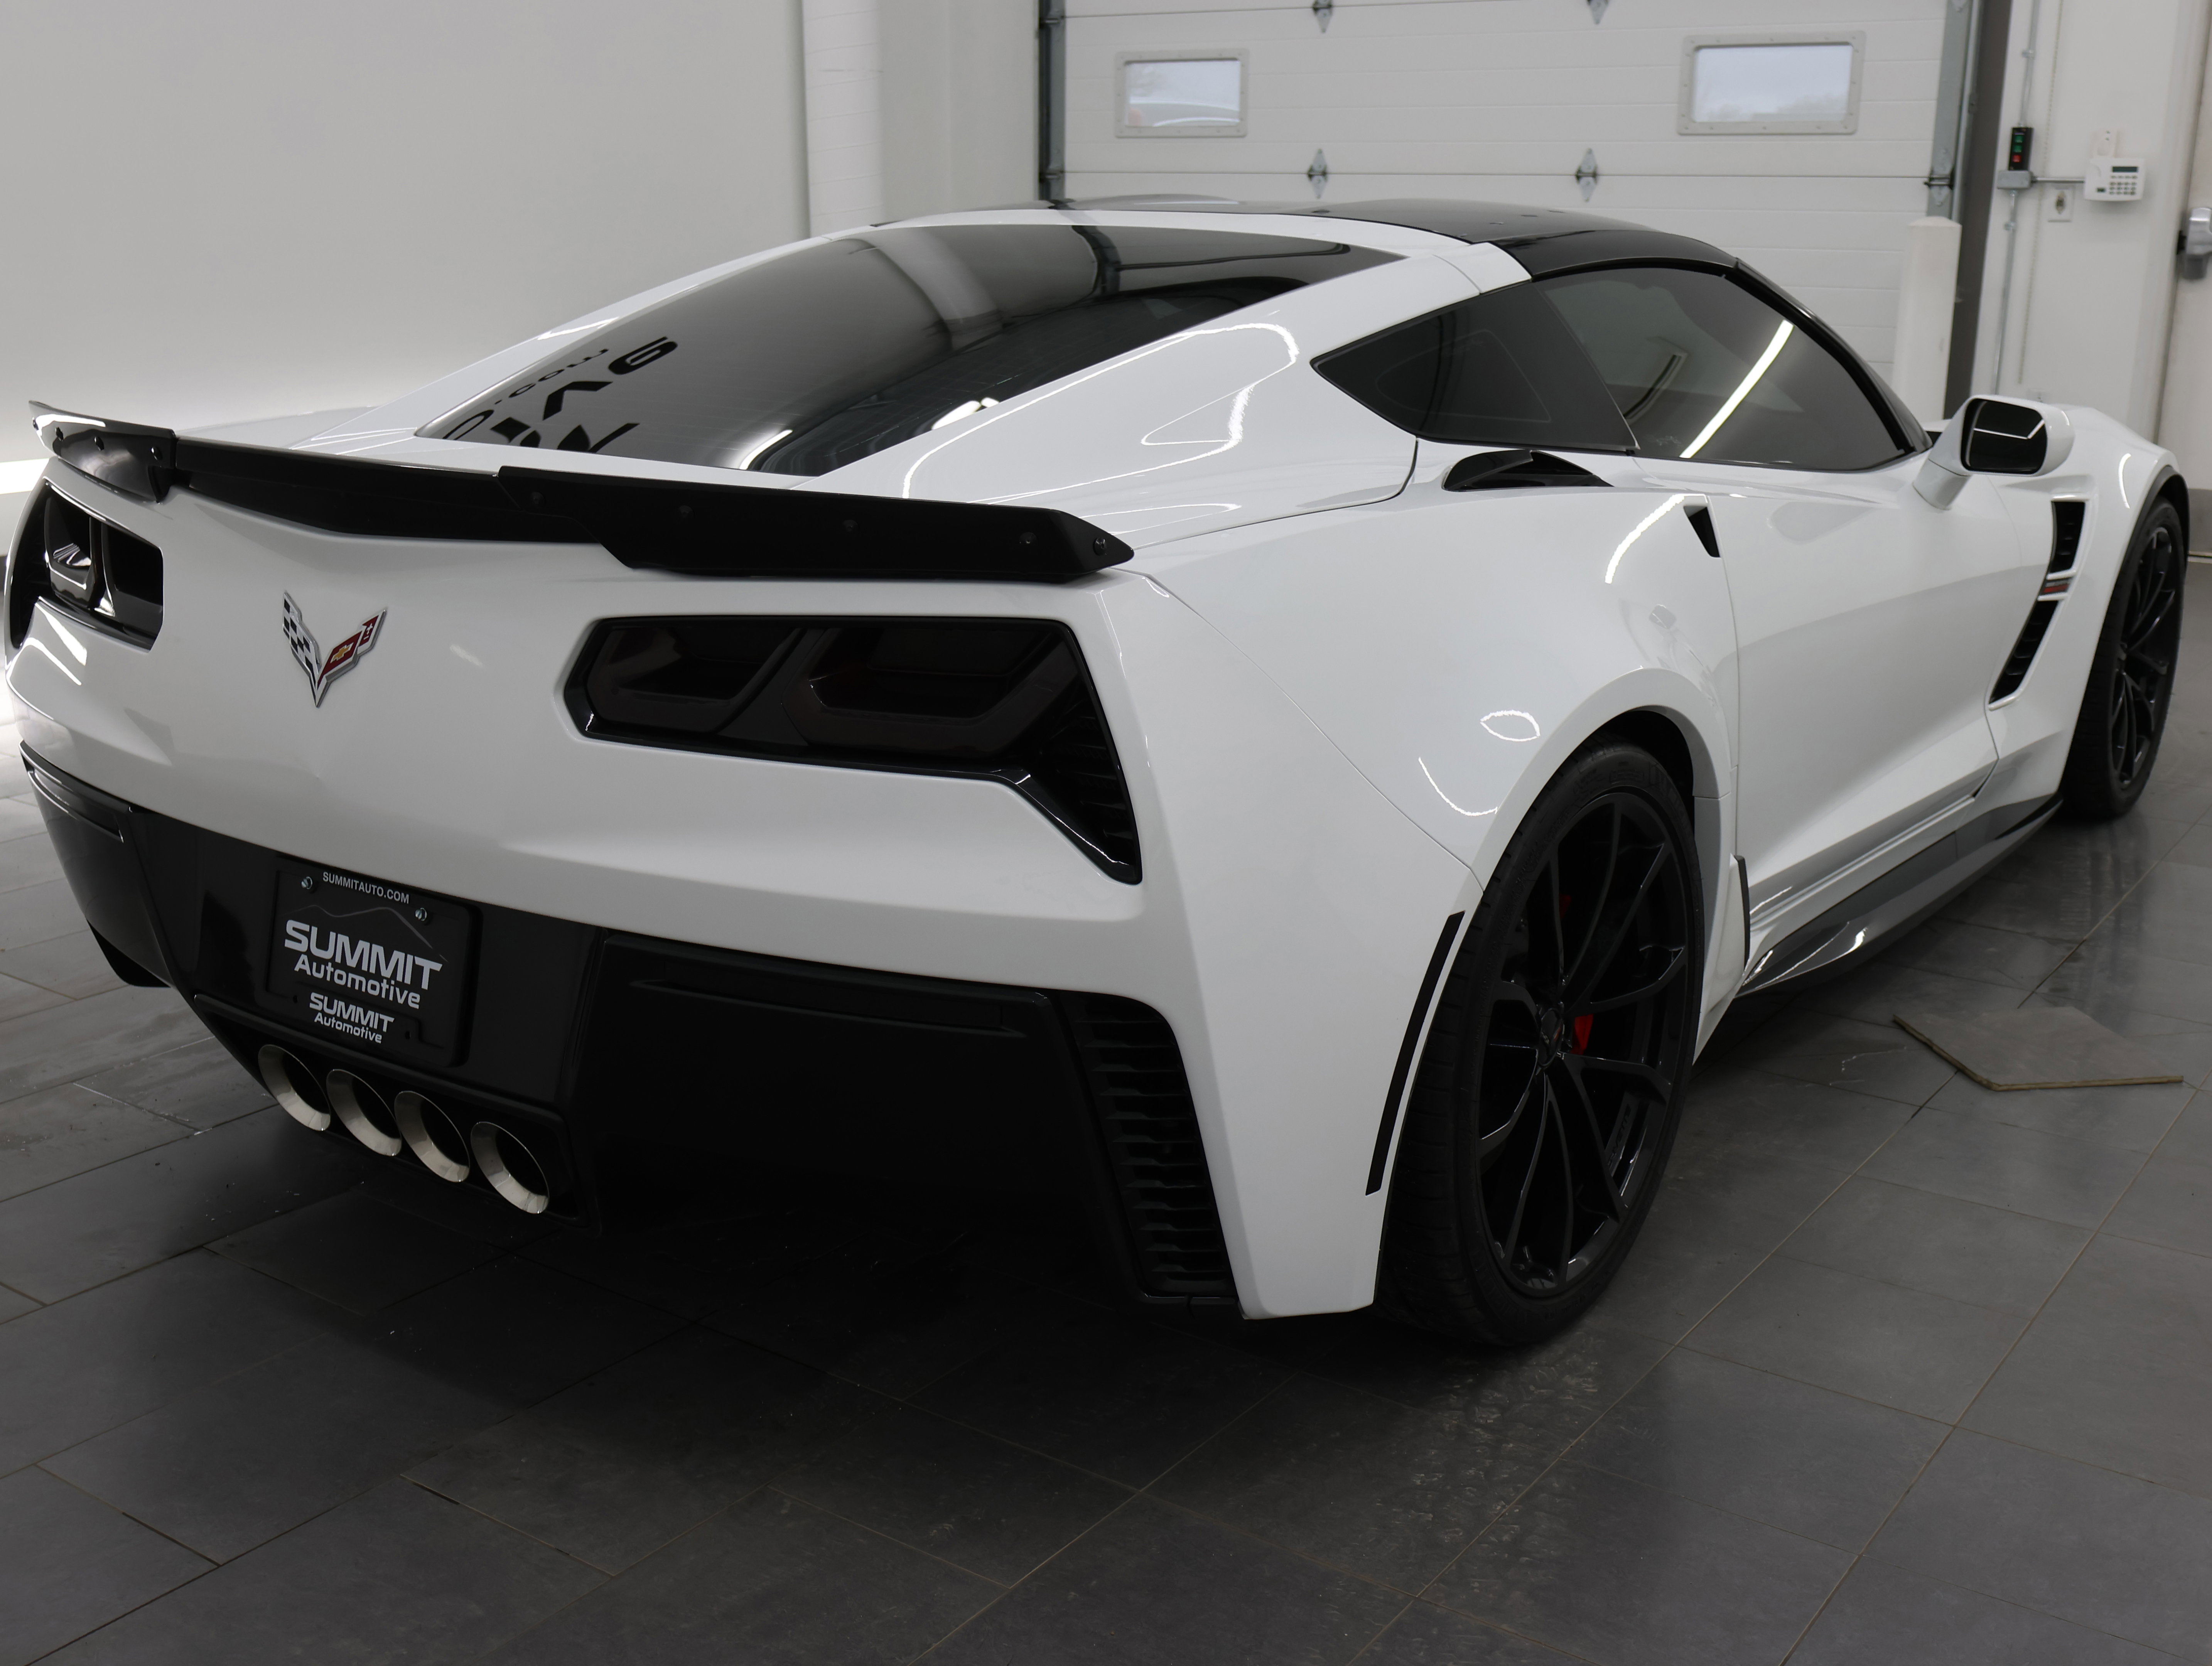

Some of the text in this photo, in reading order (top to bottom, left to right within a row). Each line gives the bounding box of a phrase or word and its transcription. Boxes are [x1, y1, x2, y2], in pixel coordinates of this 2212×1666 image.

[322, 872, 409, 904] SUMMITAUTO.COM
[284, 919, 443, 990] SUMMIT
[294, 954, 420, 1009] Automotive
[309, 992, 395, 1032] SUMMIT
[314, 1012, 383, 1044] Automotive
